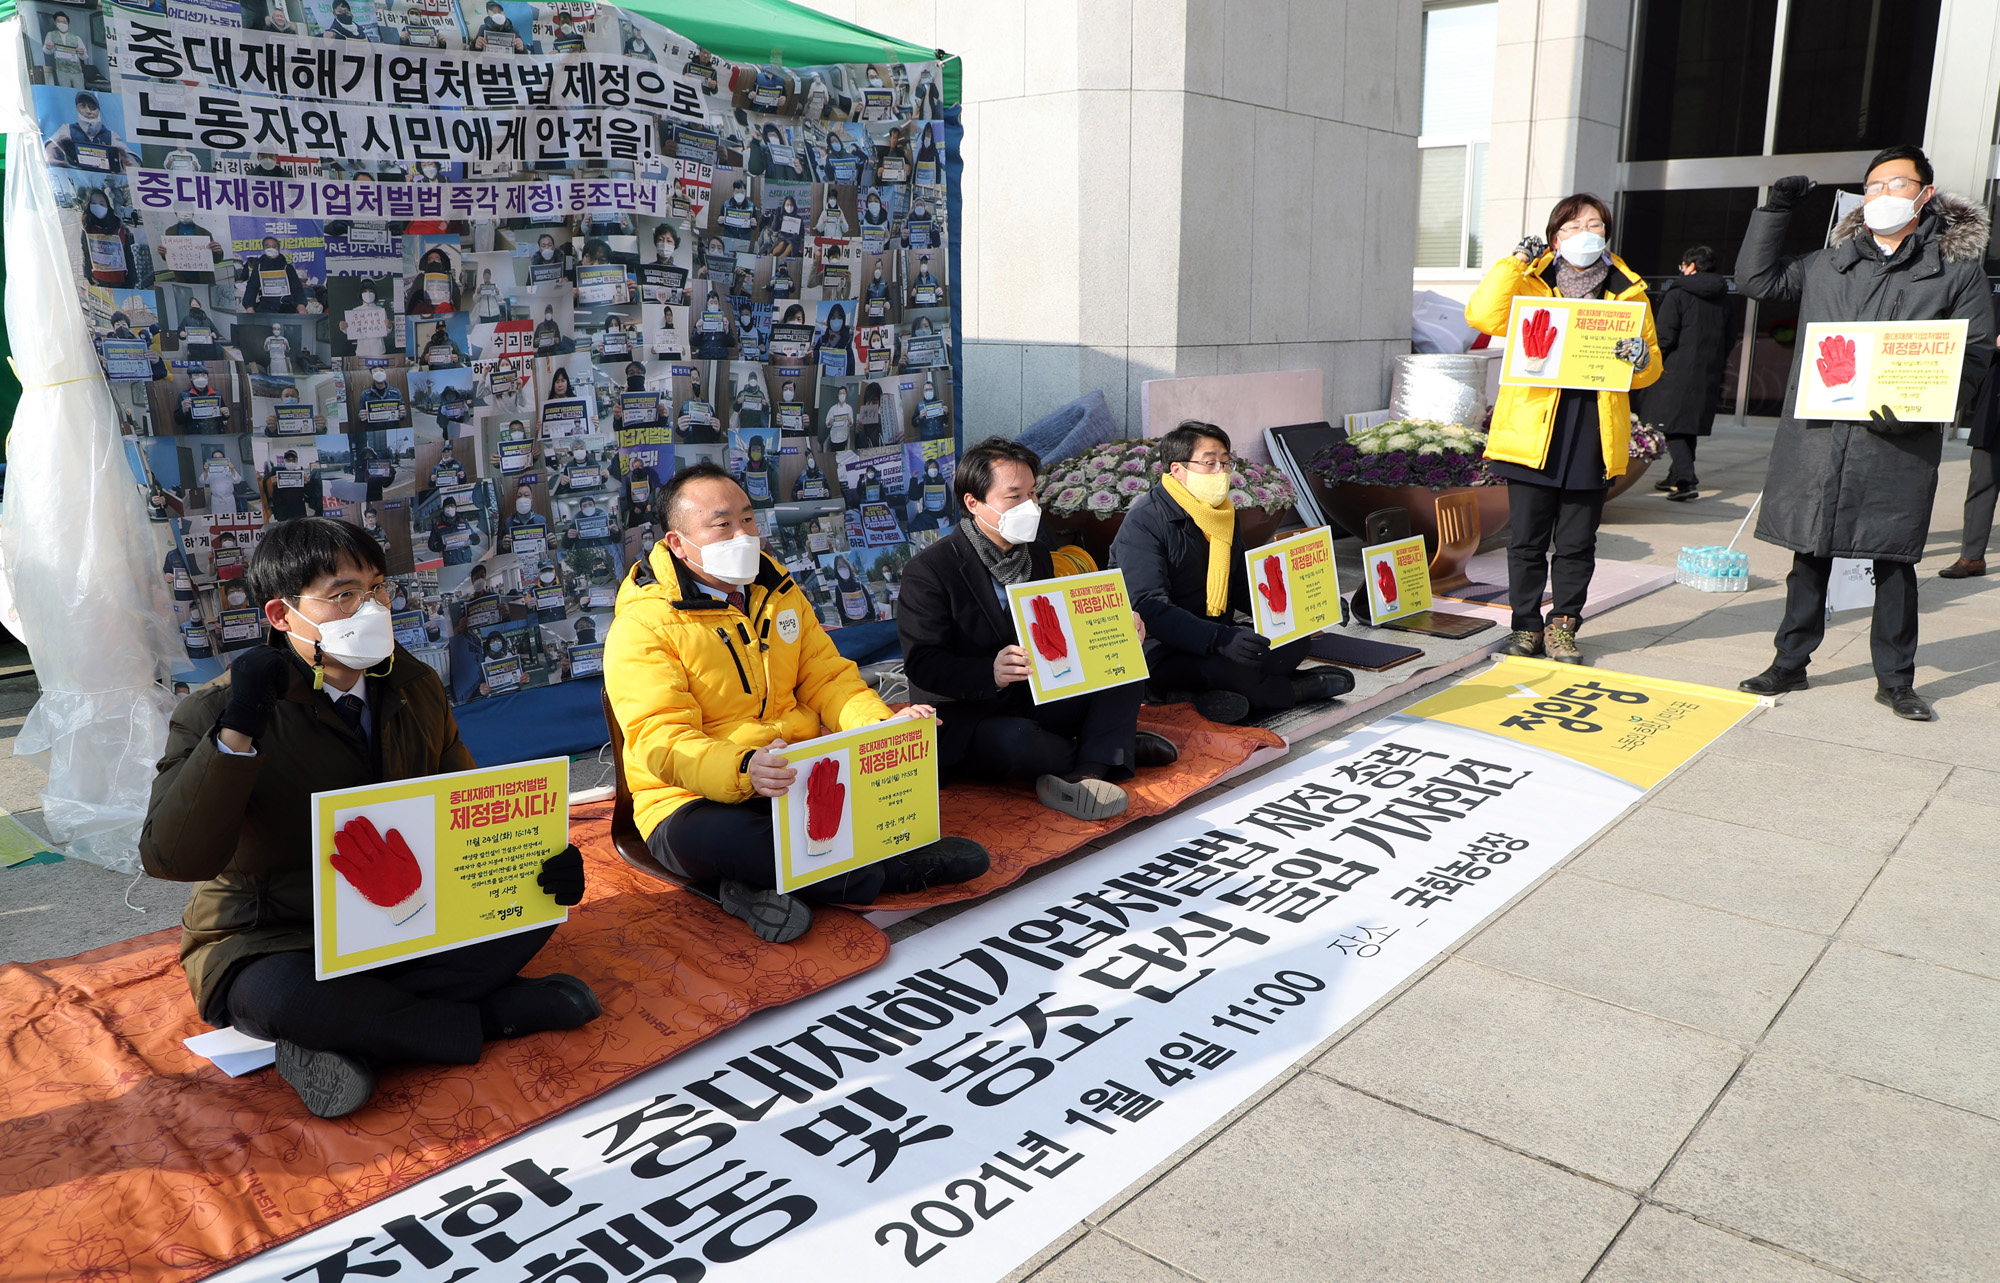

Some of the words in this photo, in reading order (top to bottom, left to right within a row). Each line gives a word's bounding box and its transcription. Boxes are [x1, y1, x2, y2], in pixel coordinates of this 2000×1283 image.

[128, 20, 554, 106] 중대재해기업처벌법
[561, 62, 704, 119] 제정으로
[136, 91, 348, 158] 노동자와
[361, 113, 528, 161] 시민에게
[536, 115, 653, 161] 안전을!
[136, 171, 442, 217] 중대재해기업처벌법
[450, 185, 499, 216] 즉각
[505, 184, 564, 214] 제정!
[568, 182, 657, 213] 동조단식
[1574, 318, 1635, 332] 제정합시다!
[1881, 341, 1956, 356] 제정합시다!
[1072, 593, 1124, 614] 제정합시다!
[1498, 681, 1650, 733] 정의당
[859, 729, 922, 755] 중대재해기업처벌법
[859, 740, 929, 775] 제정합시다!
[450, 777, 547, 805] 중대재해기업처벌법
[450, 792, 557, 831] 제정합시다!
[501, 885, 518, 894] 사망
[497, 906, 523, 921] 정의당
[582, 829, 1280, 1178] 중대재해기업처벌법
[1234, 782, 1371, 839] 제정
[1331, 742, 1450, 790] 총력
[780, 1087, 954, 1183] 및
[905, 991, 1134, 1108] 동조
[1079, 910, 1272, 1003] 단식
[1227, 847, 1380, 923] 돌입
[1329, 757, 1534, 859] 기자회견
[875, 1128, 1086, 1269] 2021년
[1064, 1080, 1164, 1136] 1월
[1144, 1031, 1238, 1089] 4일
[1211, 969, 1327, 1037] 11:00
[1326, 922, 1396, 958] 장소
[1390, 831, 1531, 909] 국회농성장
